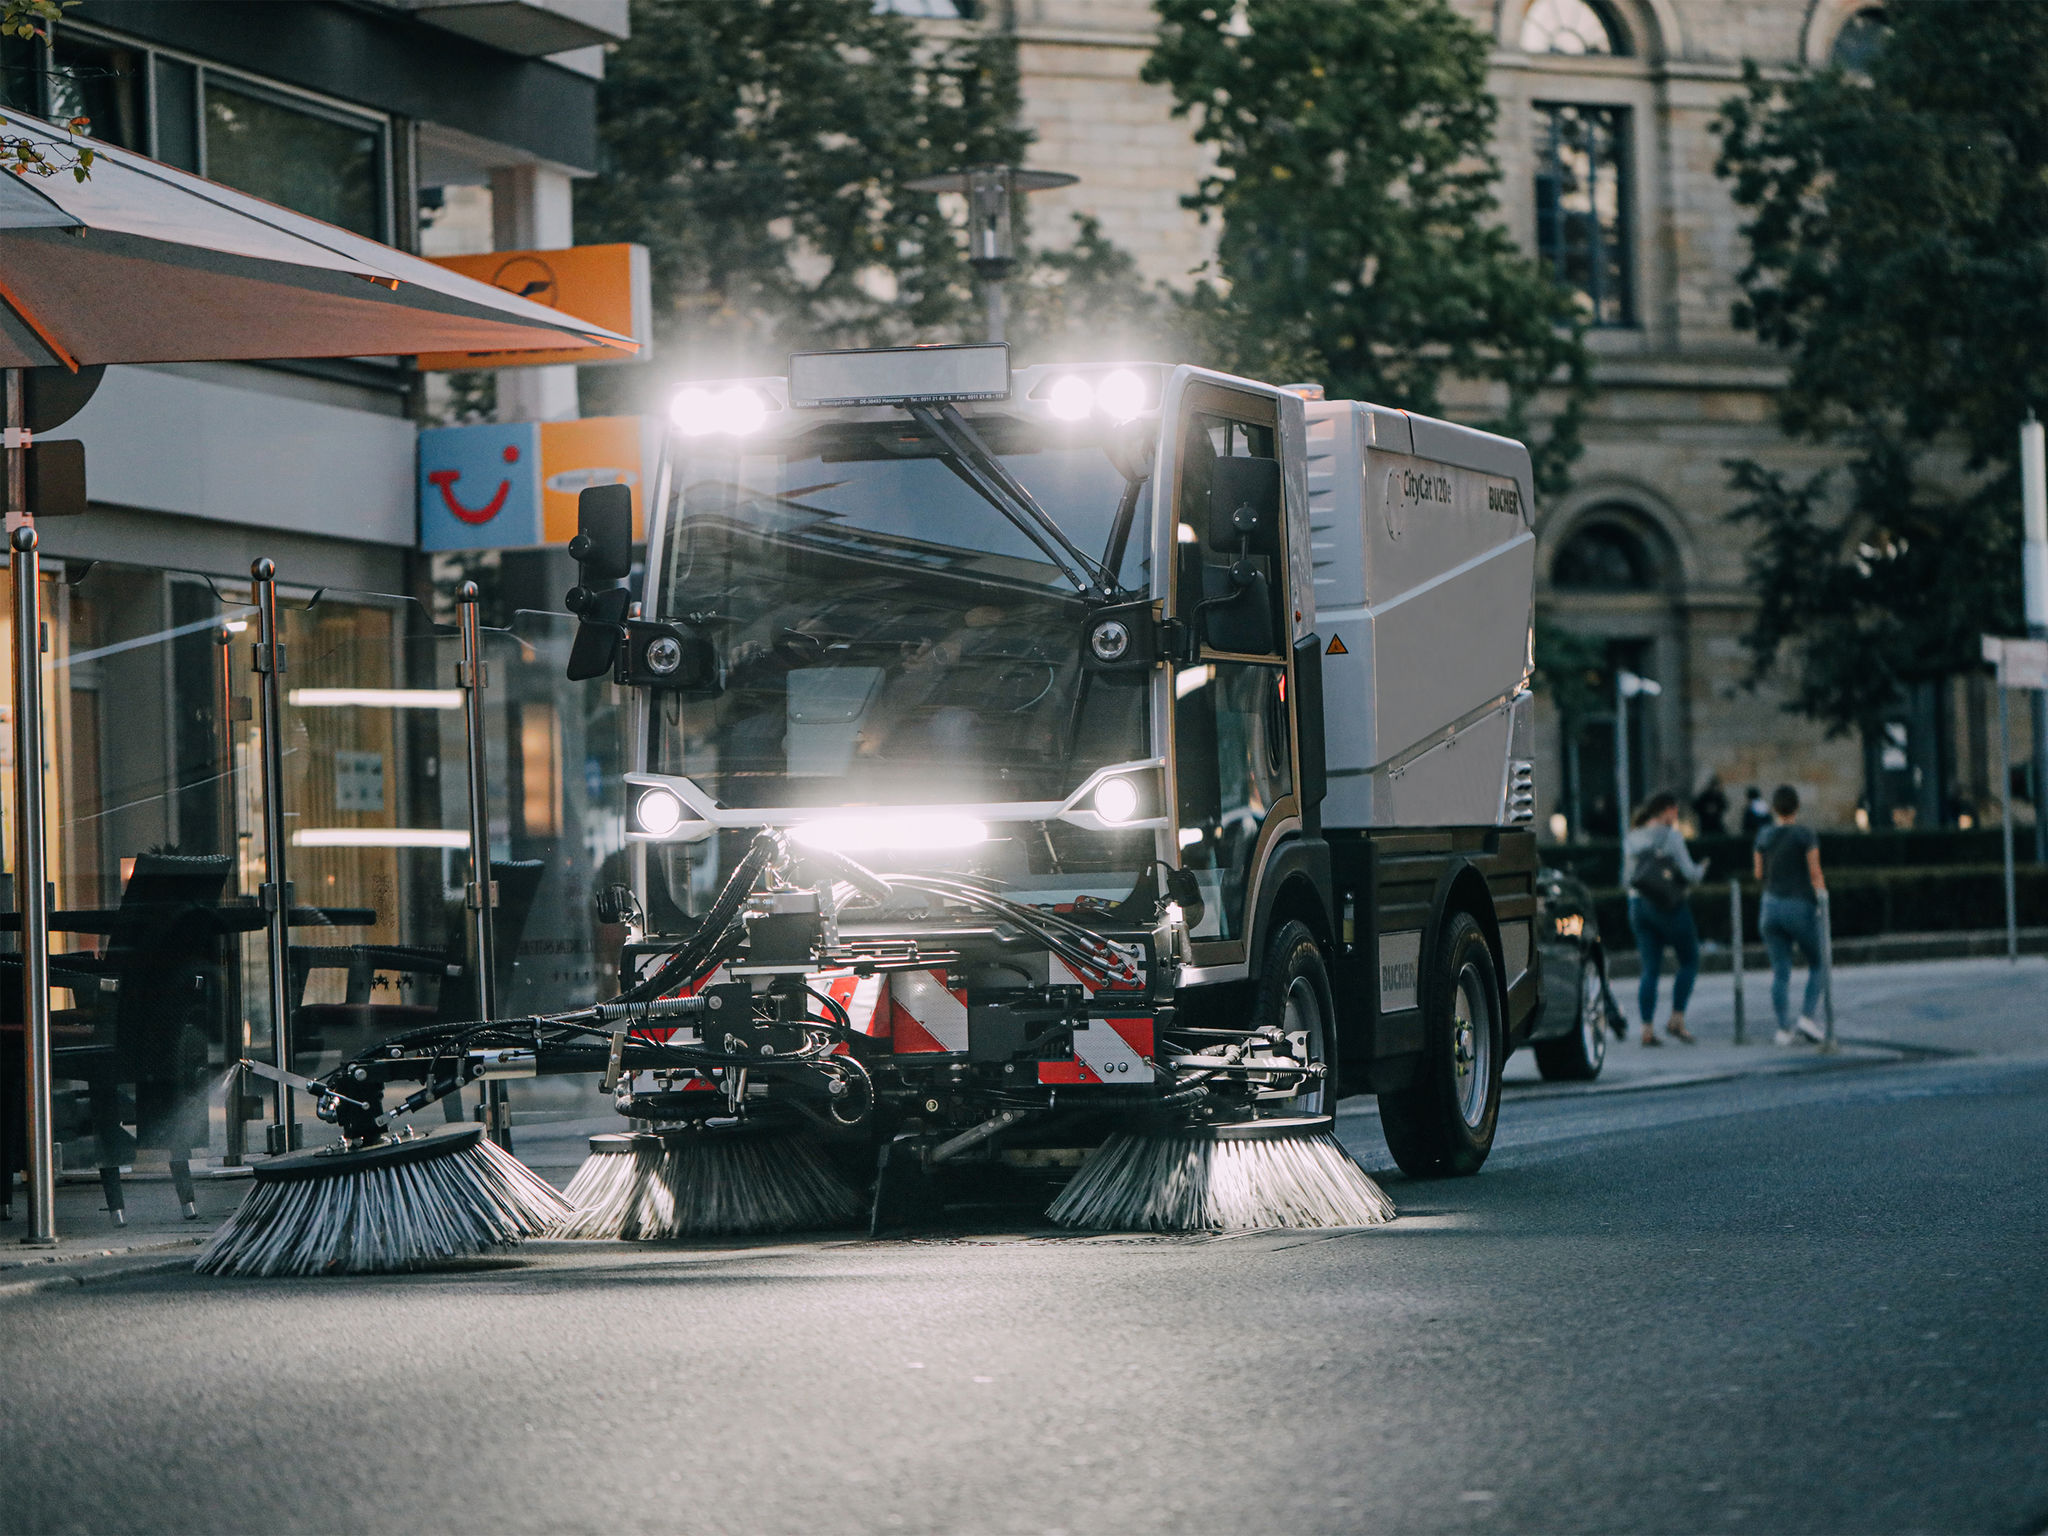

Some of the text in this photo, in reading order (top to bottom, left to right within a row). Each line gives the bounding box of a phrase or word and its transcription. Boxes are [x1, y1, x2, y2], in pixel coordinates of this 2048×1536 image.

[1404, 468, 1451, 505] CityCat V20e
[1489, 486, 1518, 515] BUCHER
[1382, 963, 1416, 992] BUCHER
